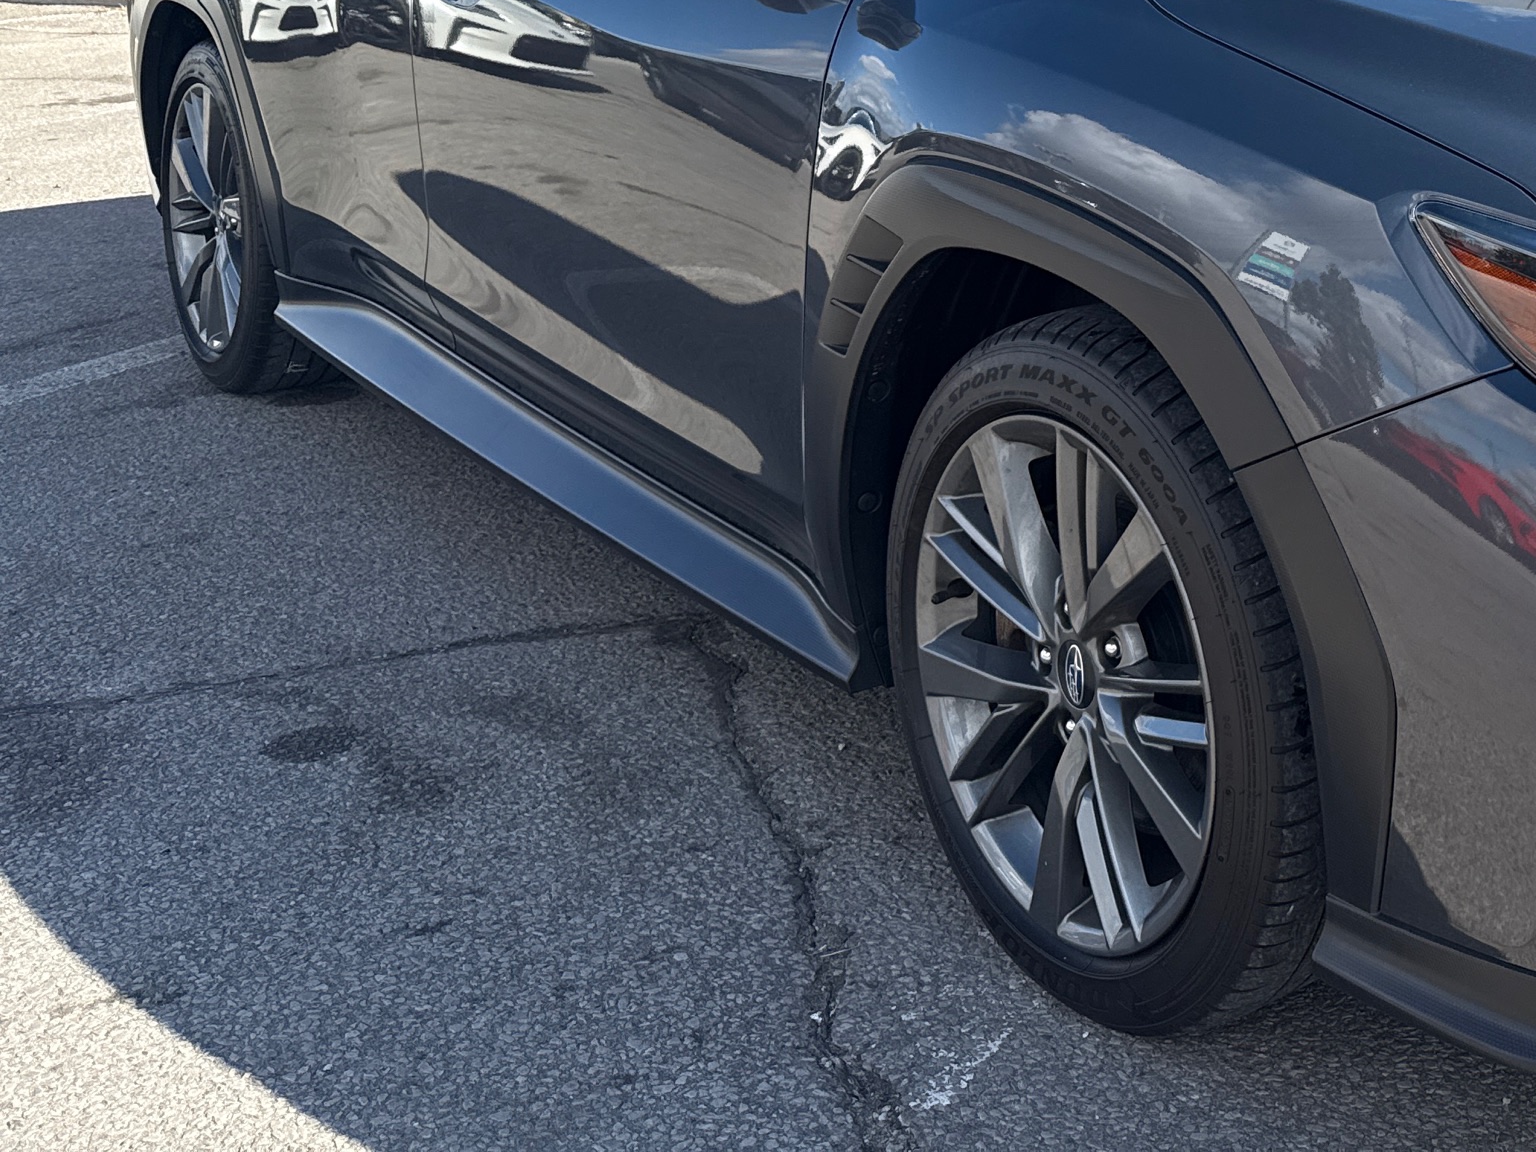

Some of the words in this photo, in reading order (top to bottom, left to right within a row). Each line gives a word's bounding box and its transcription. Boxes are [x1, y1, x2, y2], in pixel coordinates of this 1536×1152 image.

[924, 405, 944, 438] SP
[948, 364, 1014, 408] SPORT
[1019, 364, 1098, 407] MAXX
[1101, 405, 1137, 438] GT
[1138, 448, 1188, 526] 600A
